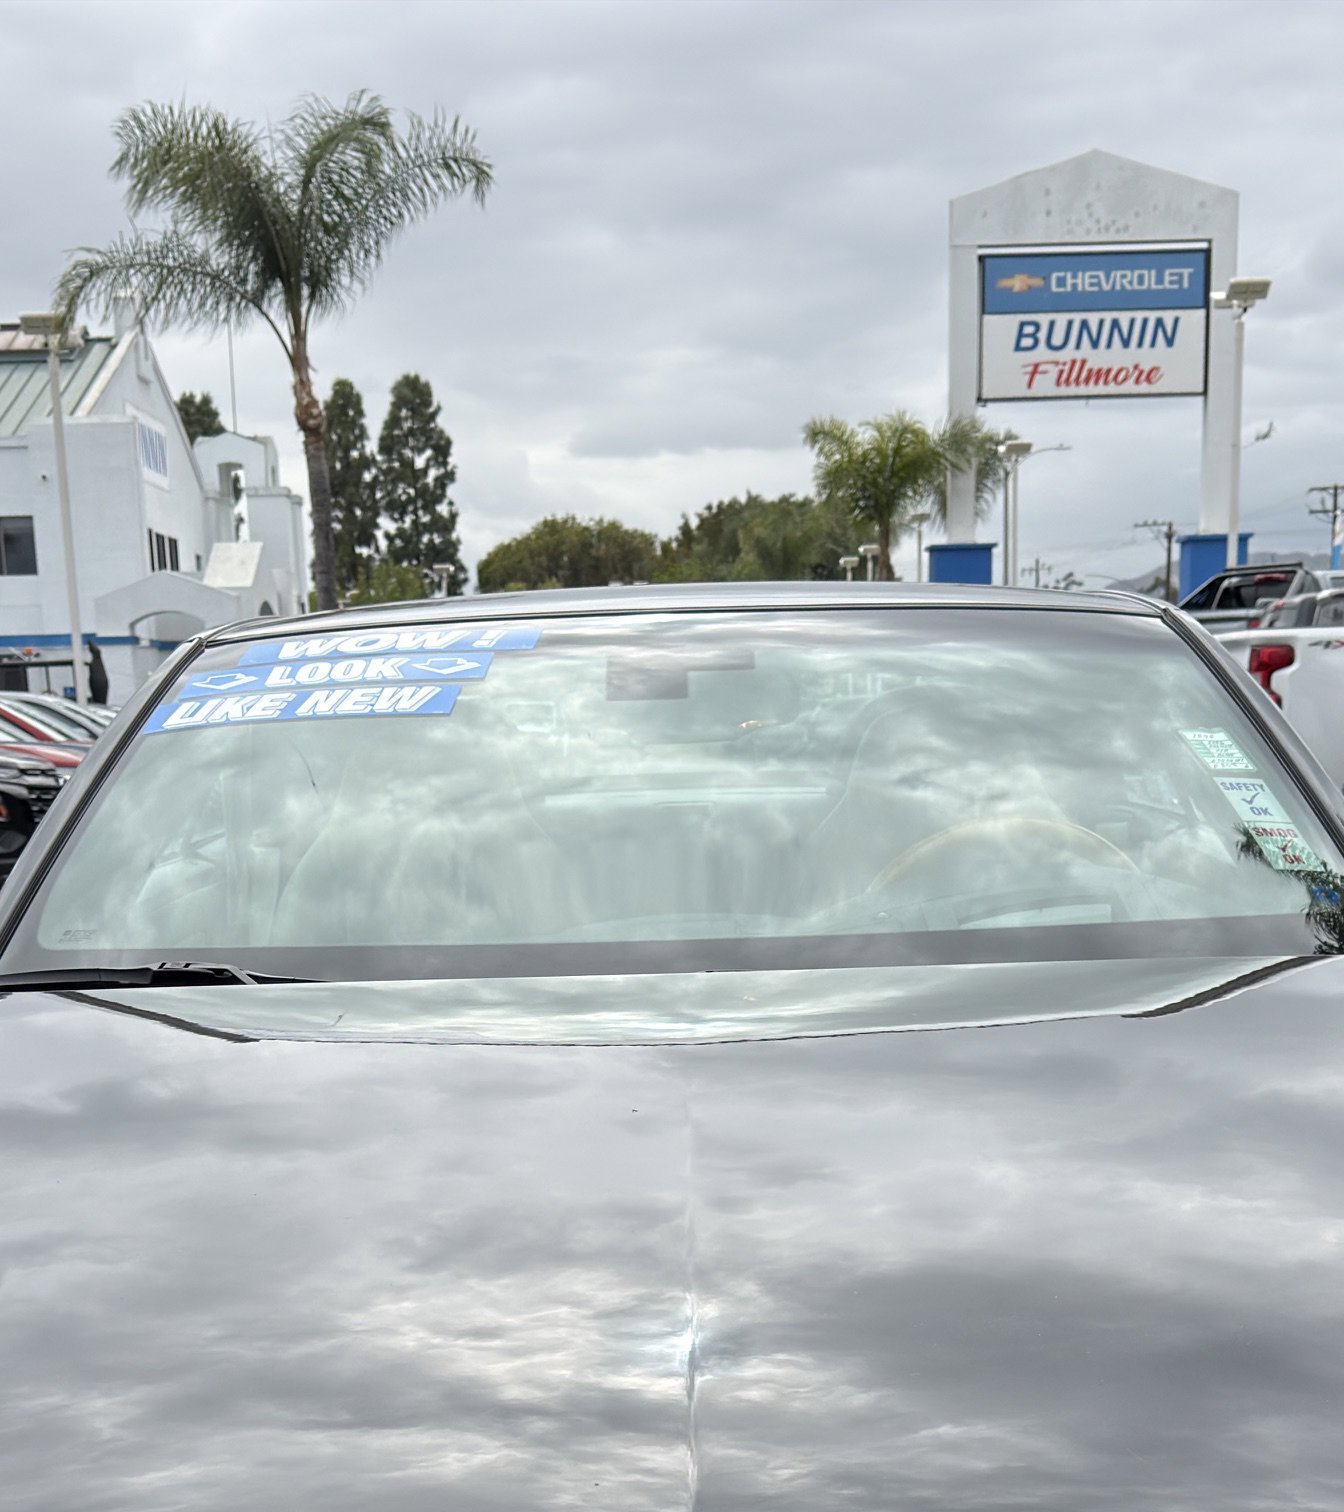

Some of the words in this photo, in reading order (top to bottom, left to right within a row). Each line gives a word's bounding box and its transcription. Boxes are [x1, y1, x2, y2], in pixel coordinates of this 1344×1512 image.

[1050, 267, 1194, 293] CHEVROLET
[1013, 316, 1180, 352] BUNNIN
[1021, 358, 1164, 390] Fillmore
[264, 657, 411, 688] LOOK
[161, 691, 298, 730] LIKE
[295, 686, 442, 717] NEW
[1220, 782, 1266, 793] SAFETY
[1249, 806, 1273, 817] OK
[1252, 827, 1298, 839] SMOG
[1283, 854, 1306, 865] OK
